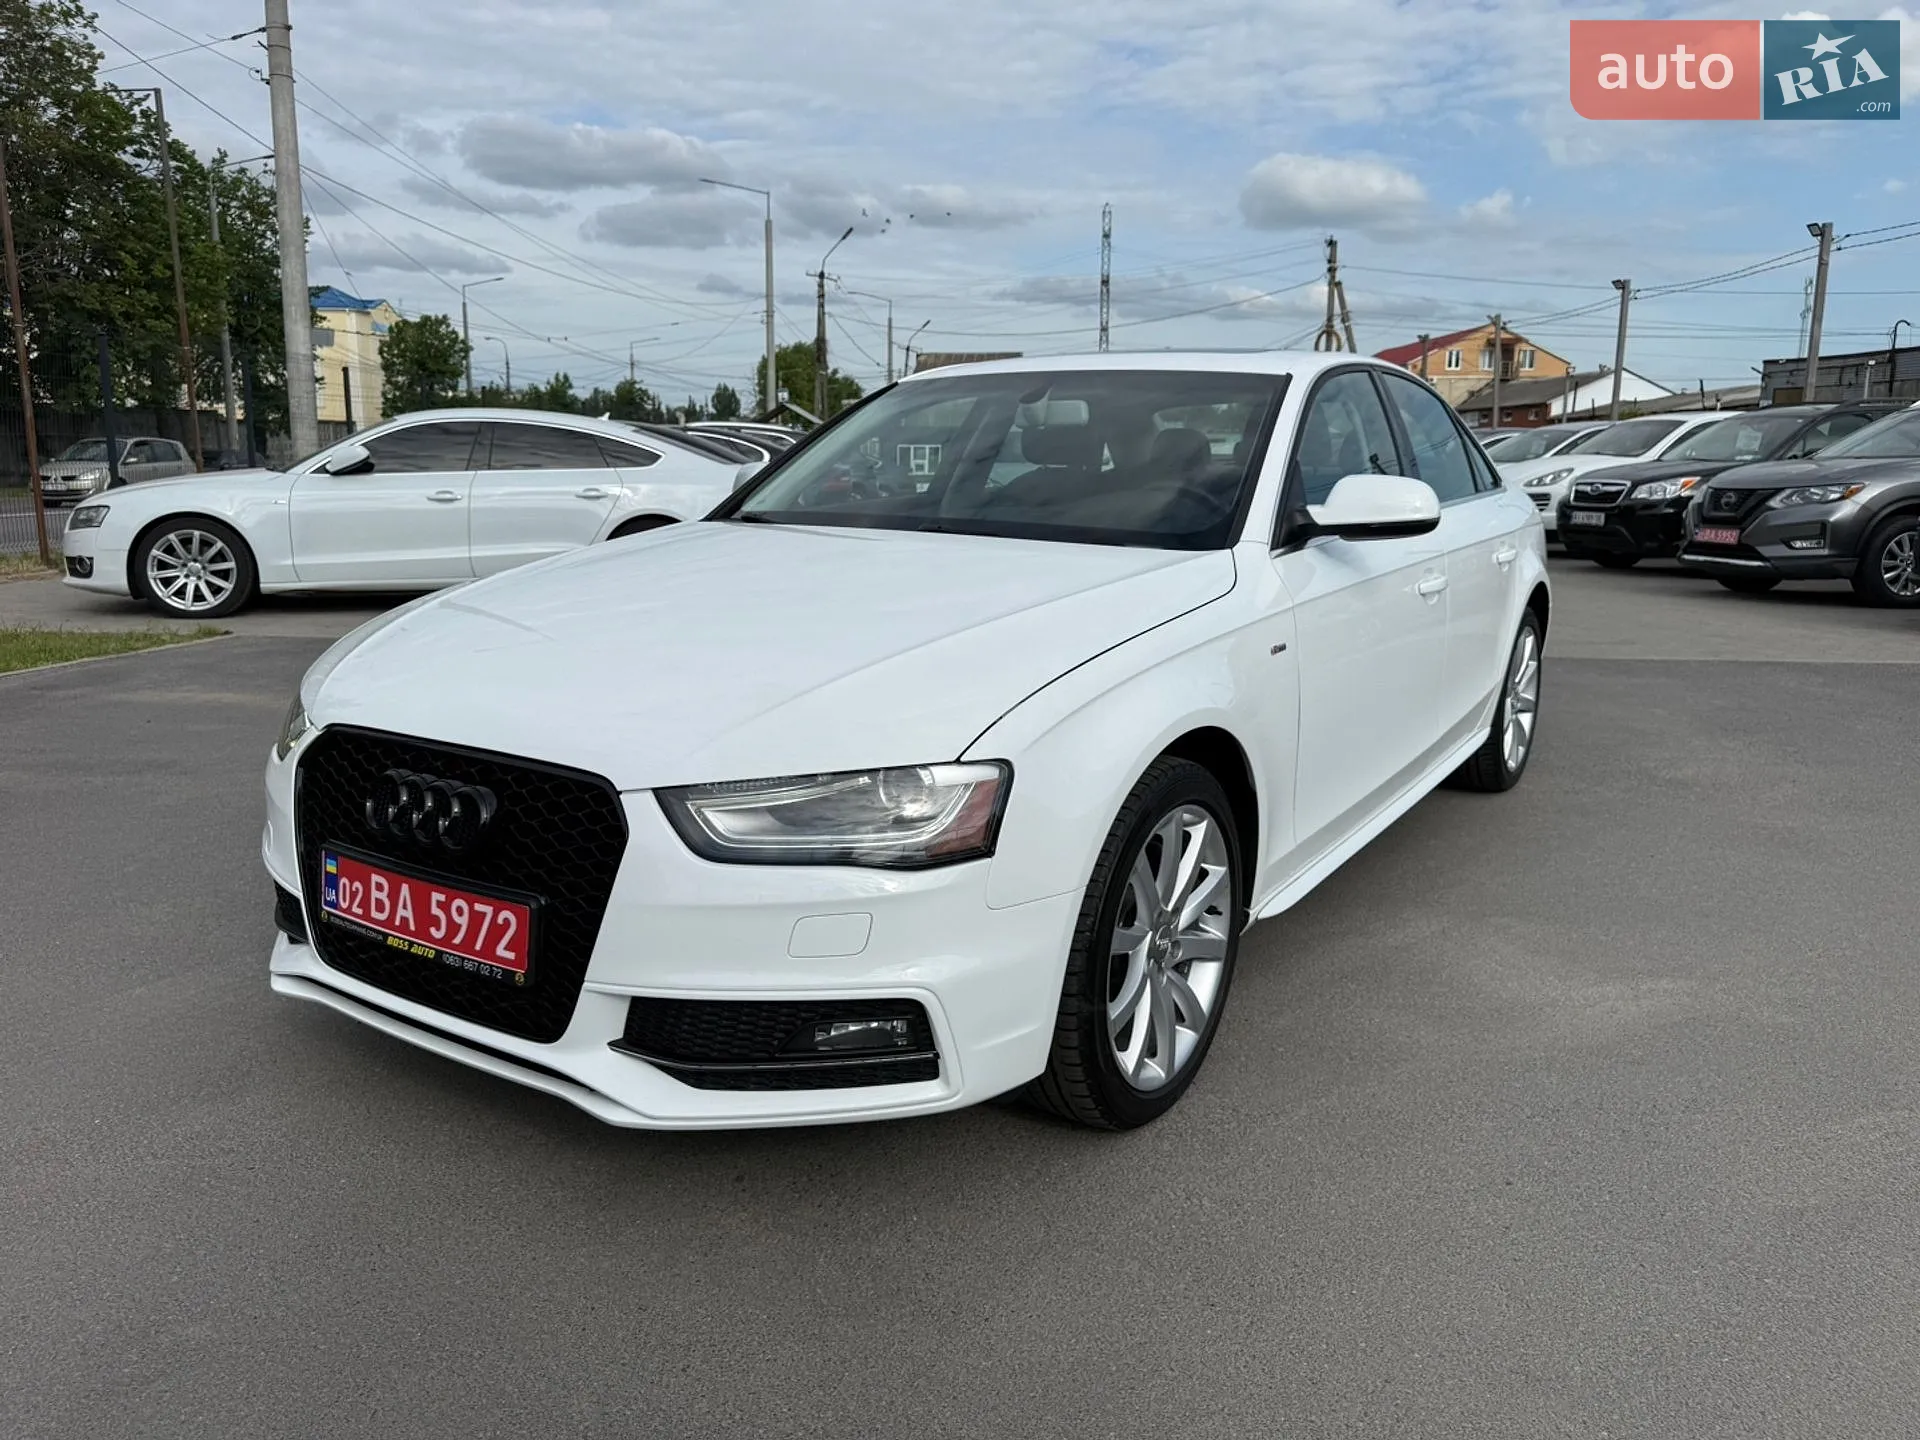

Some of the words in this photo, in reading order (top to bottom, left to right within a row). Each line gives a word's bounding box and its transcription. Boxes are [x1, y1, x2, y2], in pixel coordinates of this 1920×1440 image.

[325, 887, 336, 903] UA
[338, 877, 363, 915] 02
[371, 873, 415, 931] BA
[430, 891, 517, 960] 5972
[387, 936, 409, 950] BOSS
[491, 966, 503, 979] 72
